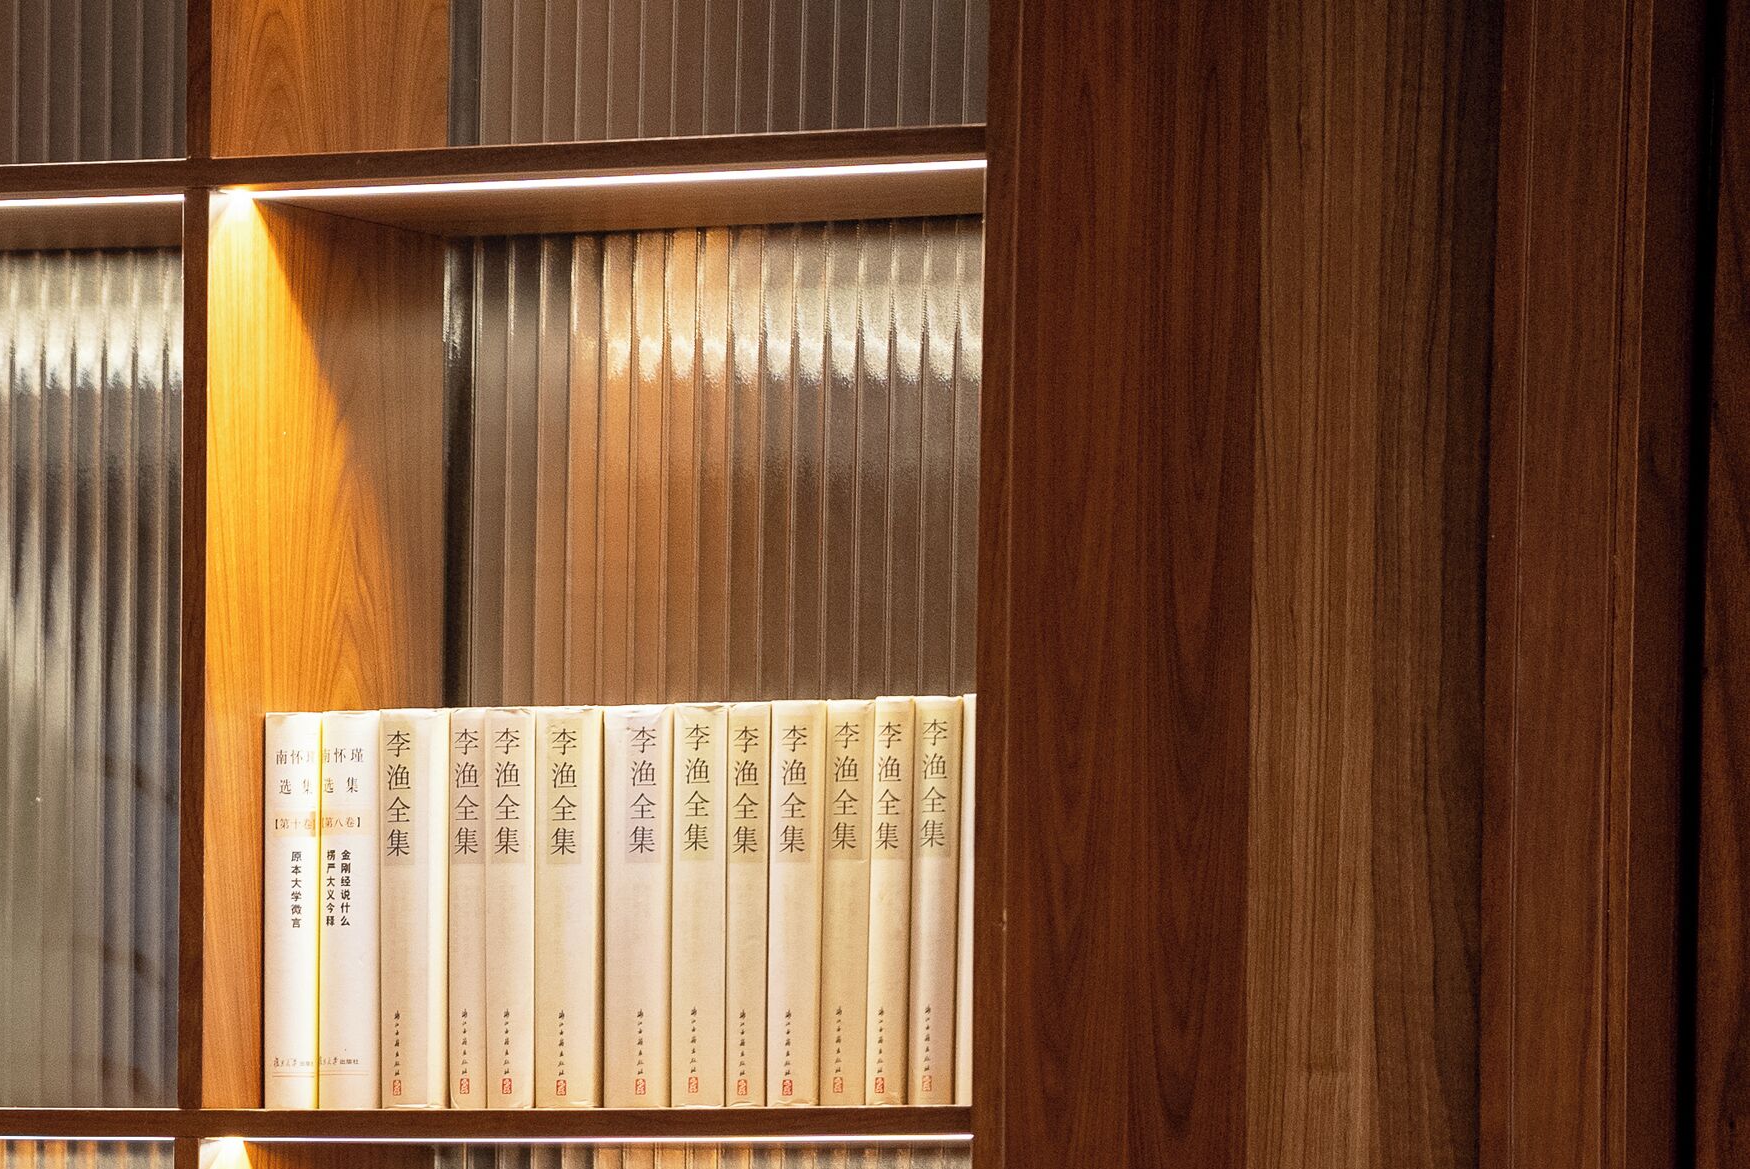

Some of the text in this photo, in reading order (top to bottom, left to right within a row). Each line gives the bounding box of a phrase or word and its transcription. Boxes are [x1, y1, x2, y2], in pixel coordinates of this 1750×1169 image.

[324, 777, 358, 793] 选集
[386, 731, 411, 856] 李渔全集
[454, 728, 479, 855] 李渔全集
[495, 728, 520, 855] 李渔全集
[550, 729, 577, 856] 李渔全集
[630, 726, 656, 854] 李渔全集
[684, 723, 710, 852] 李渔全集
[732, 726, 759, 854] 李渔全集
[780, 726, 808, 854] 李渔全集
[831, 721, 860, 850] 李渔全集
[874, 721, 902, 850] 李渔全集
[920, 719, 948, 848] 李渔全集
[291, 851, 302, 928] 原本大学微言
[326, 849, 336, 926] 楞严大义今释
[340, 849, 351, 926] 金刚经说什么
